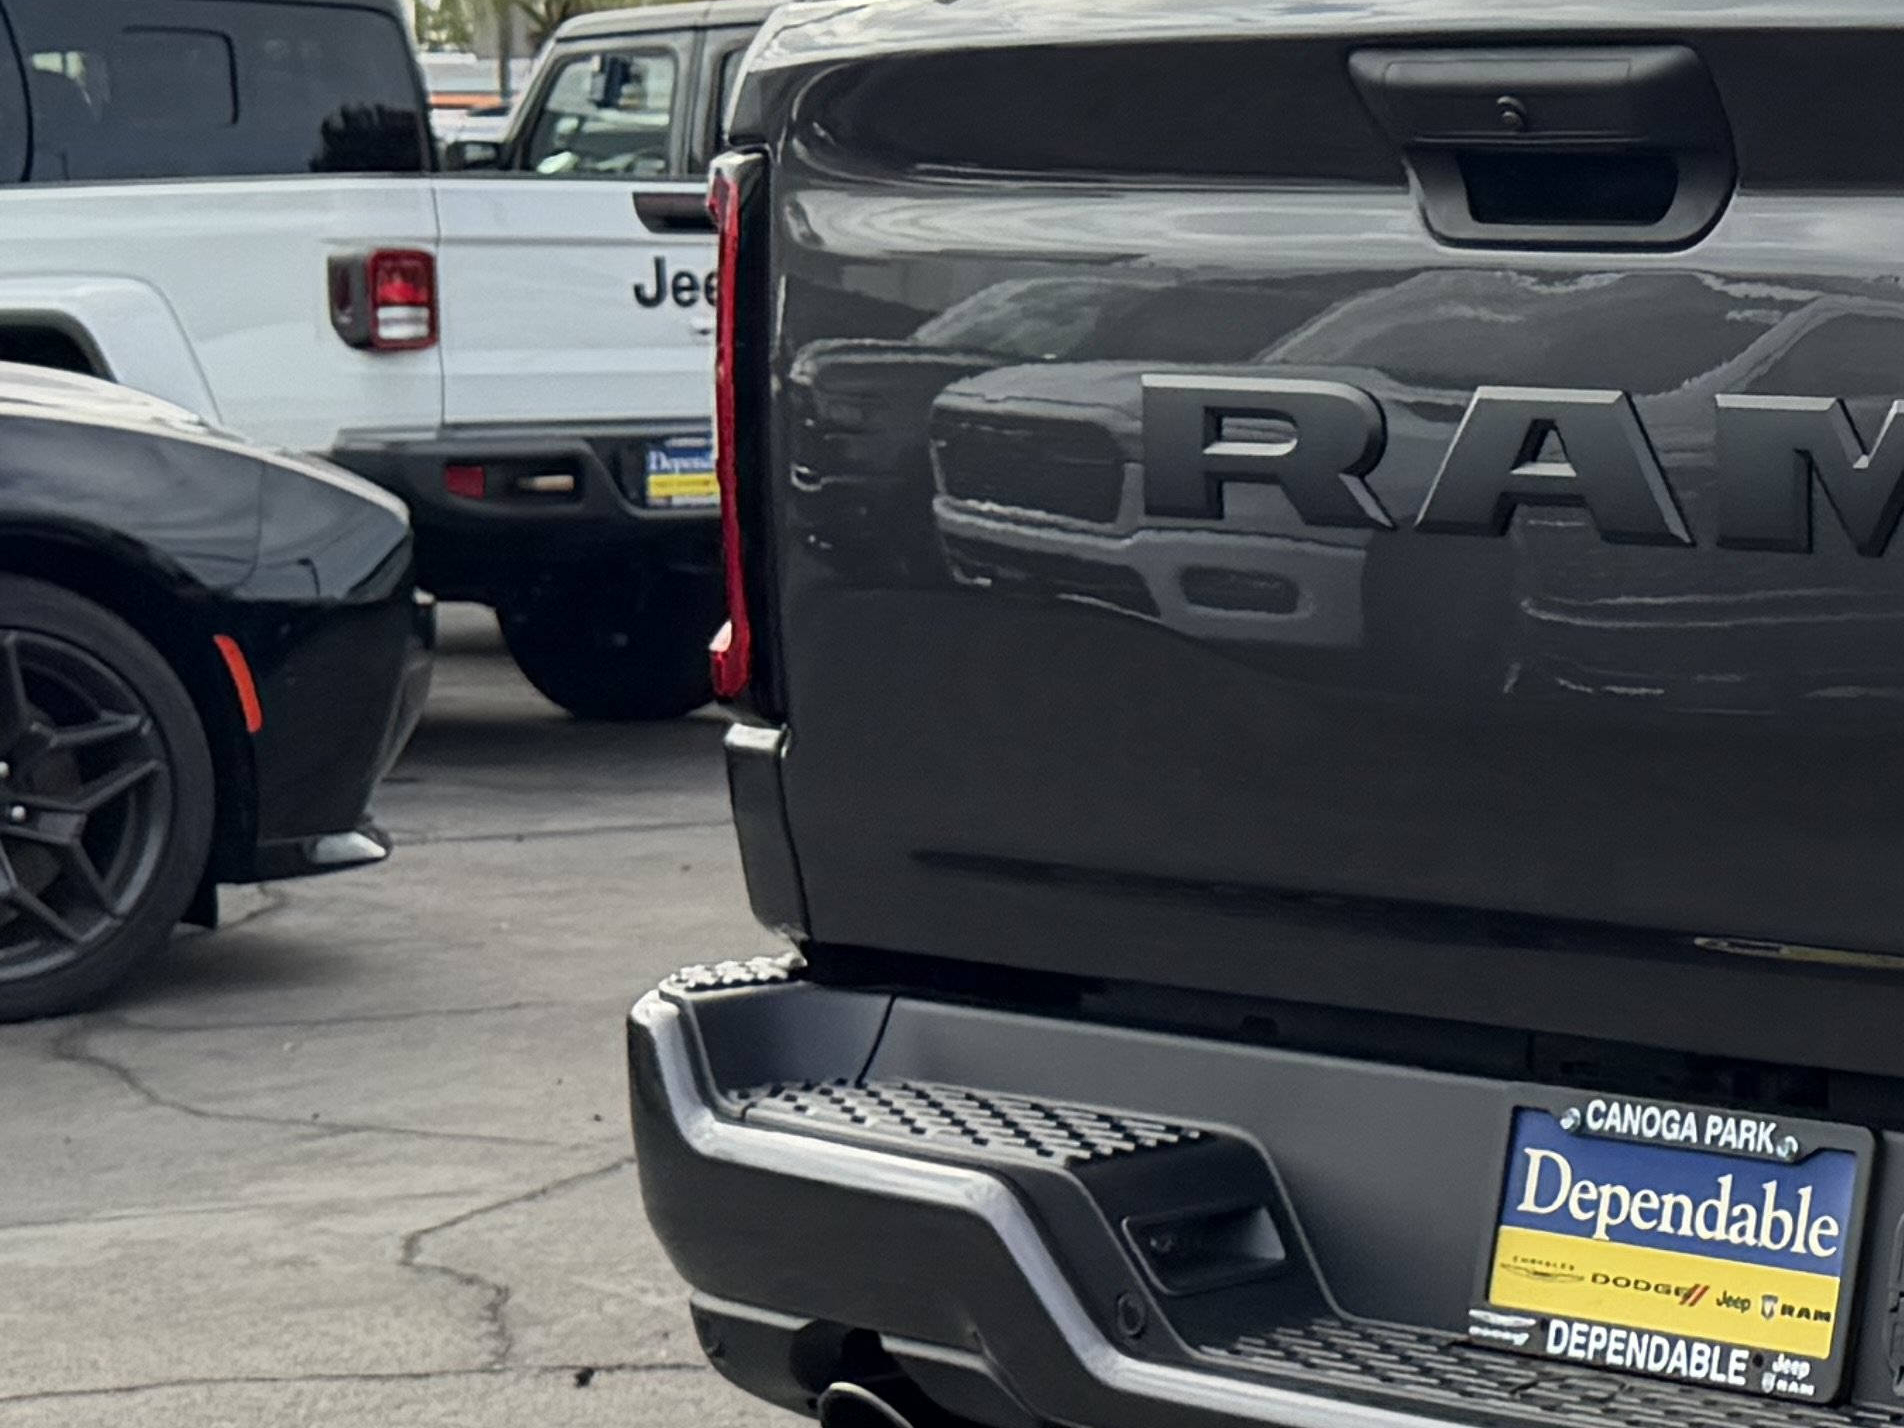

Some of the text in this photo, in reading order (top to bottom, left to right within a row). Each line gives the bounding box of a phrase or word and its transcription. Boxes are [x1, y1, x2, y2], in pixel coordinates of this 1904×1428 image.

[1586, 1099, 1777, 1155] CANOGA PARK
[1517, 1147, 1840, 1257] Dependable
[1591, 1272, 1692, 1297] DODGE
[1716, 1290, 1751, 1314] Jeep
[1781, 1303, 1831, 1323] RAM
[1546, 1319, 1750, 1386] DEPENDABLE
[1772, 1353, 1811, 1380] Jeep
[1776, 1379, 1815, 1397] RAM
